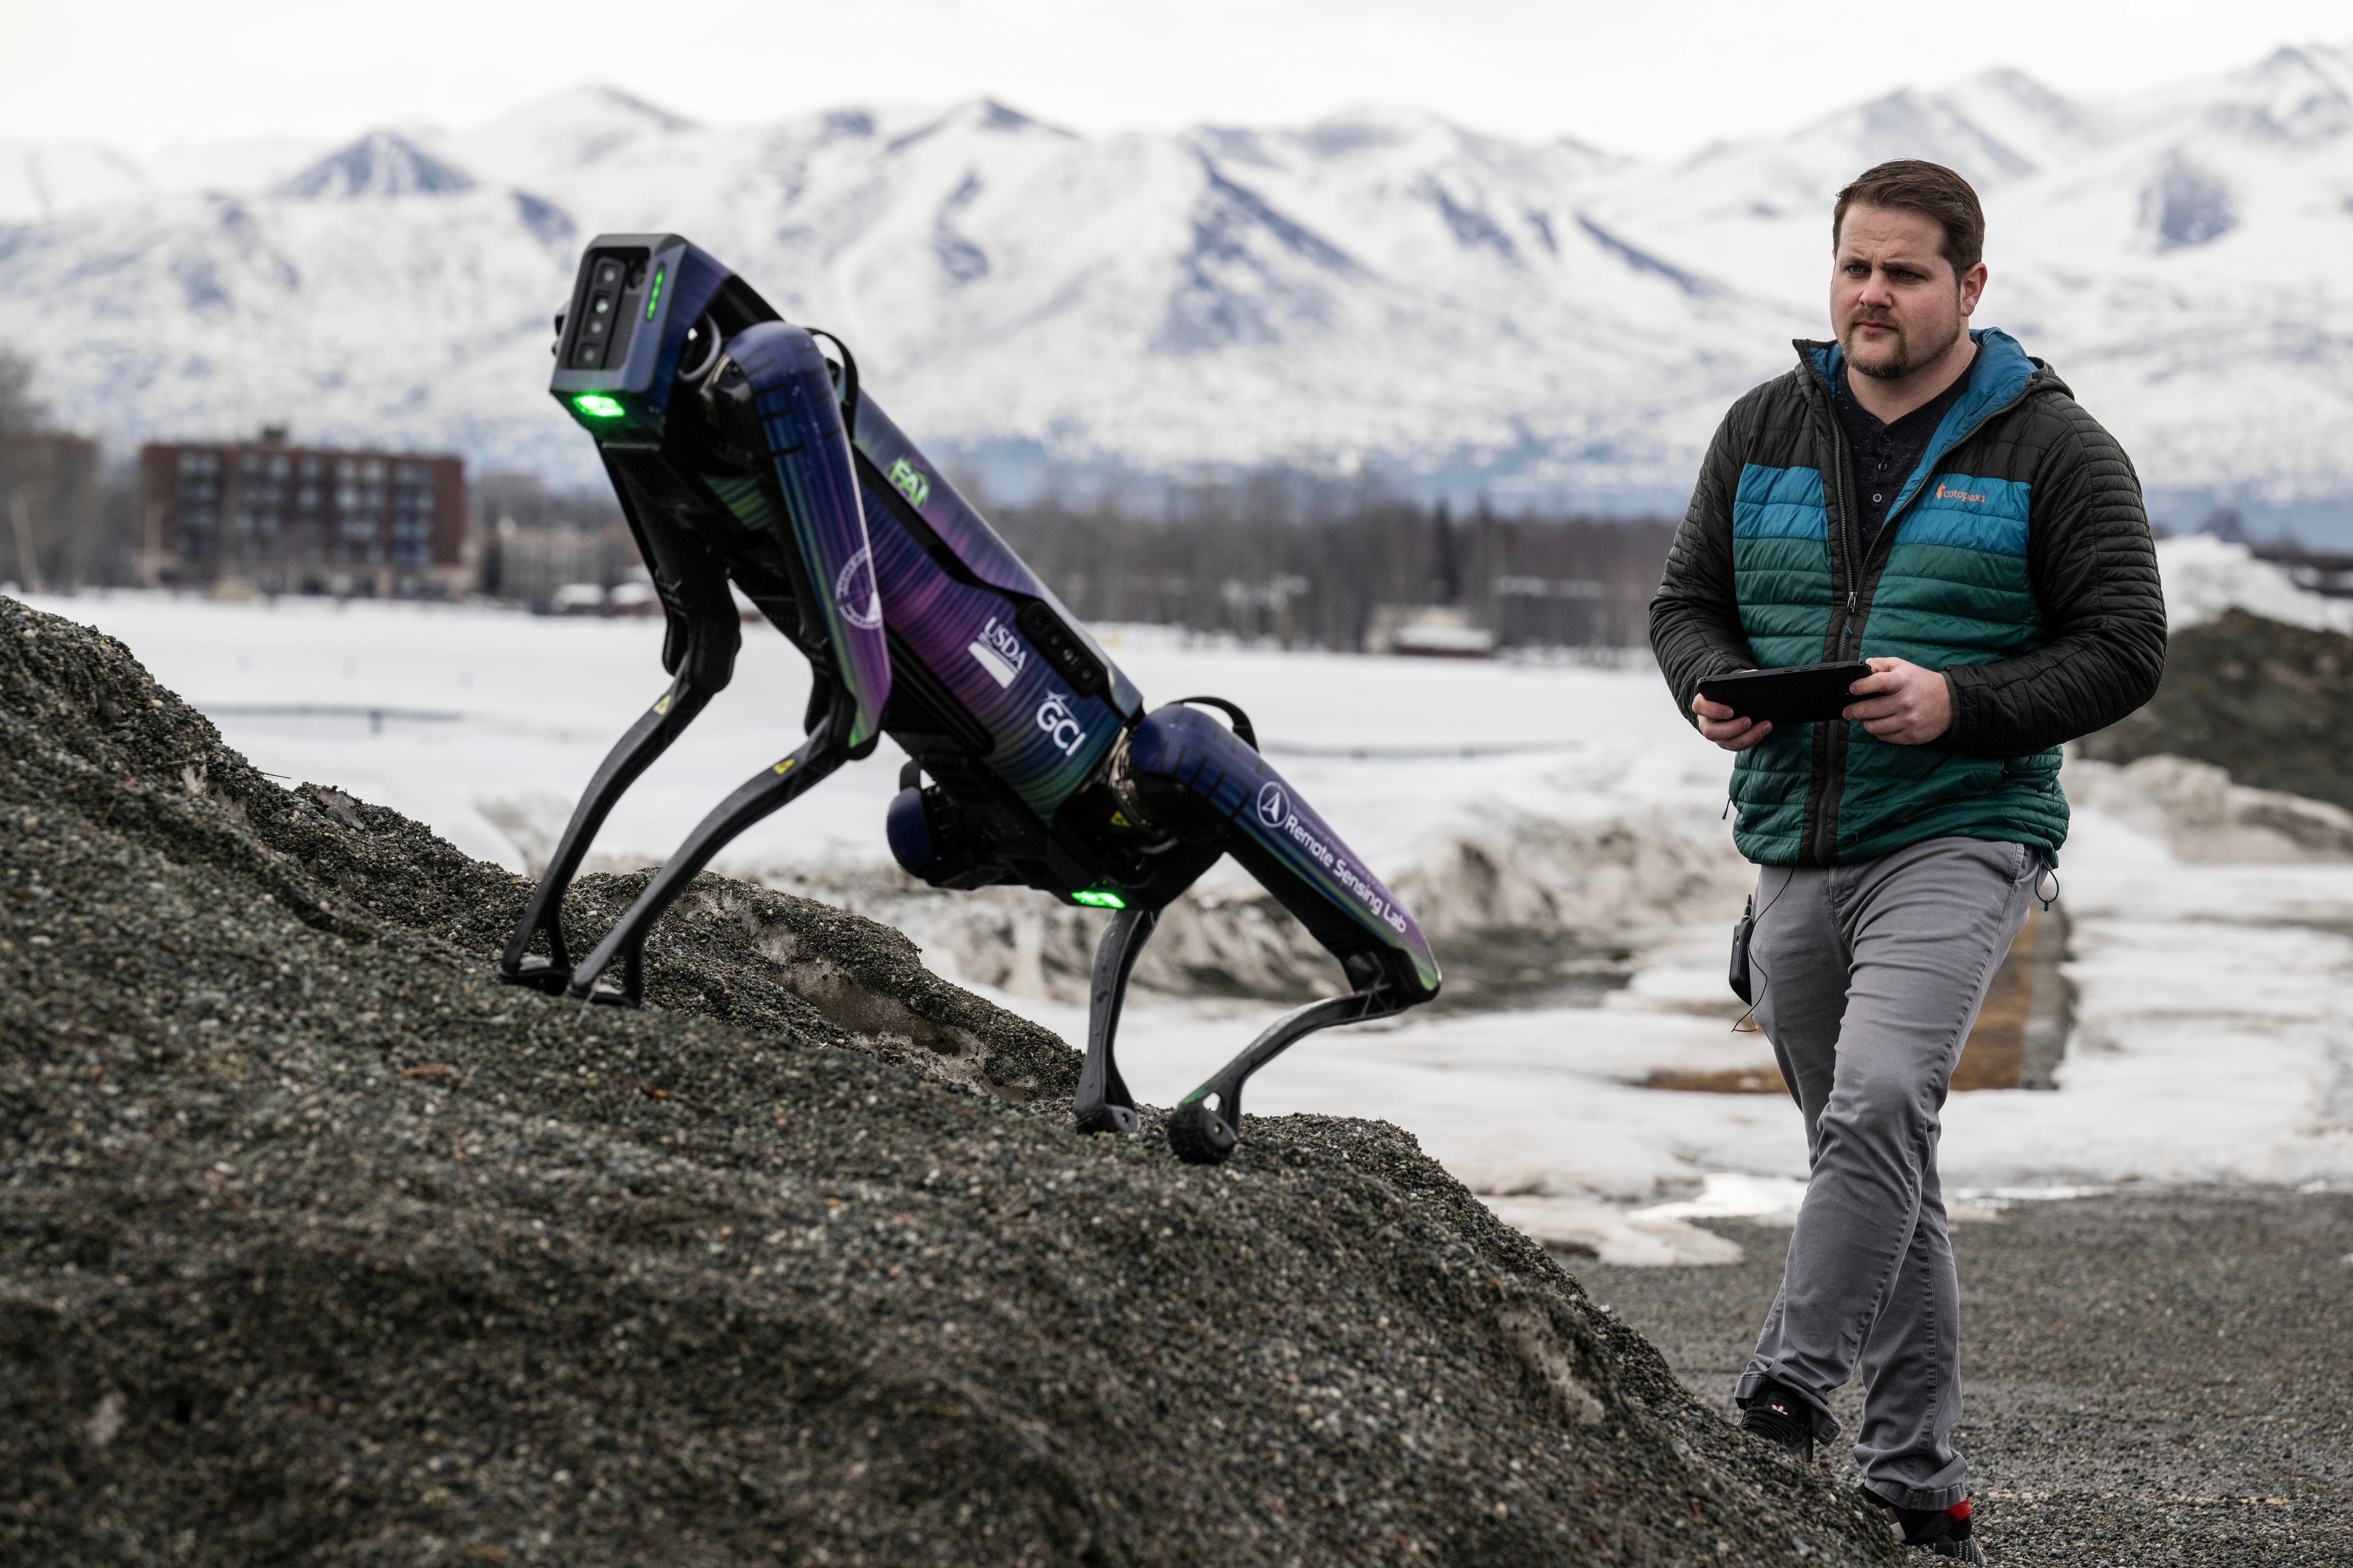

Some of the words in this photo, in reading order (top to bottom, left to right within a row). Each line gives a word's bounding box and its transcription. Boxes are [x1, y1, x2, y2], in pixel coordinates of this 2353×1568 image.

[1943, 490, 1985, 503] cotopaxi
[984, 616, 1027, 672] USDA
[1036, 701, 1086, 757] GCI
[1285, 814, 1333, 868] Remote
[1333, 859, 1383, 915] Sensing
[1384, 903, 1407, 933] Lab
